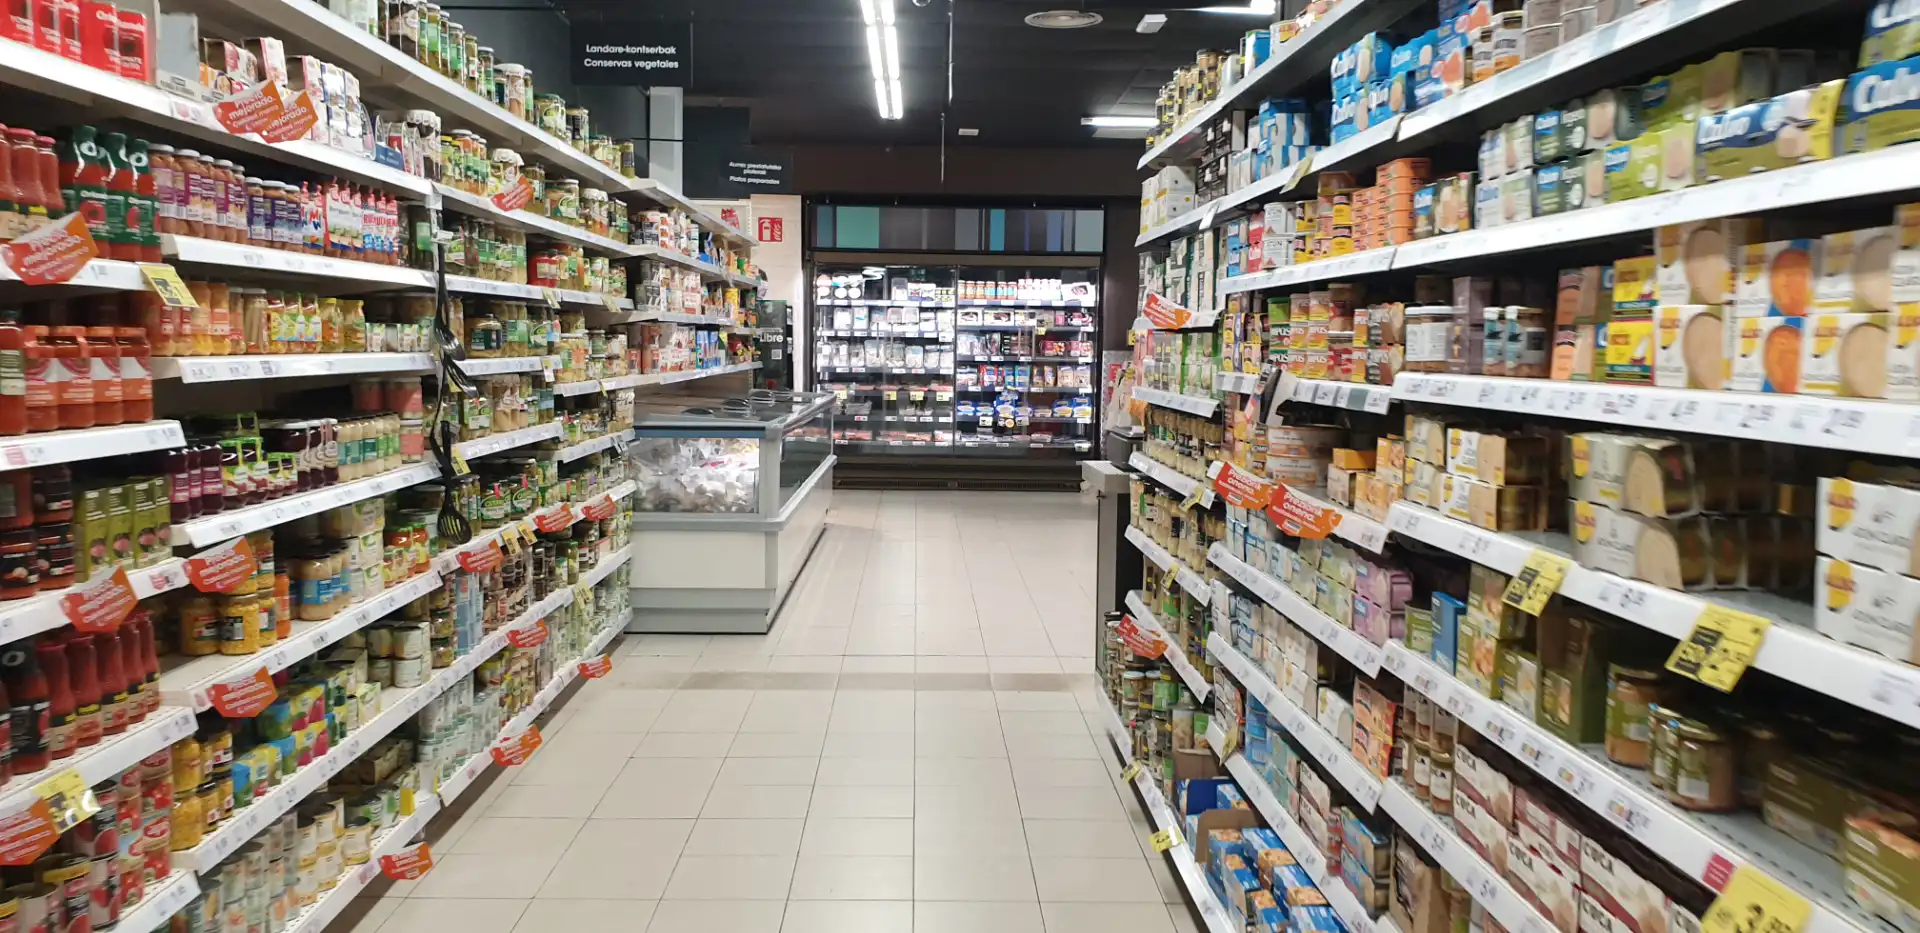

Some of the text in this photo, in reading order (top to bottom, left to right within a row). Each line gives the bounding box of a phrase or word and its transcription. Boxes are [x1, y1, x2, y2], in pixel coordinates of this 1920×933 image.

[584, 58, 679, 70] Conservas vegetales
[759, 331, 784, 343] Libre
